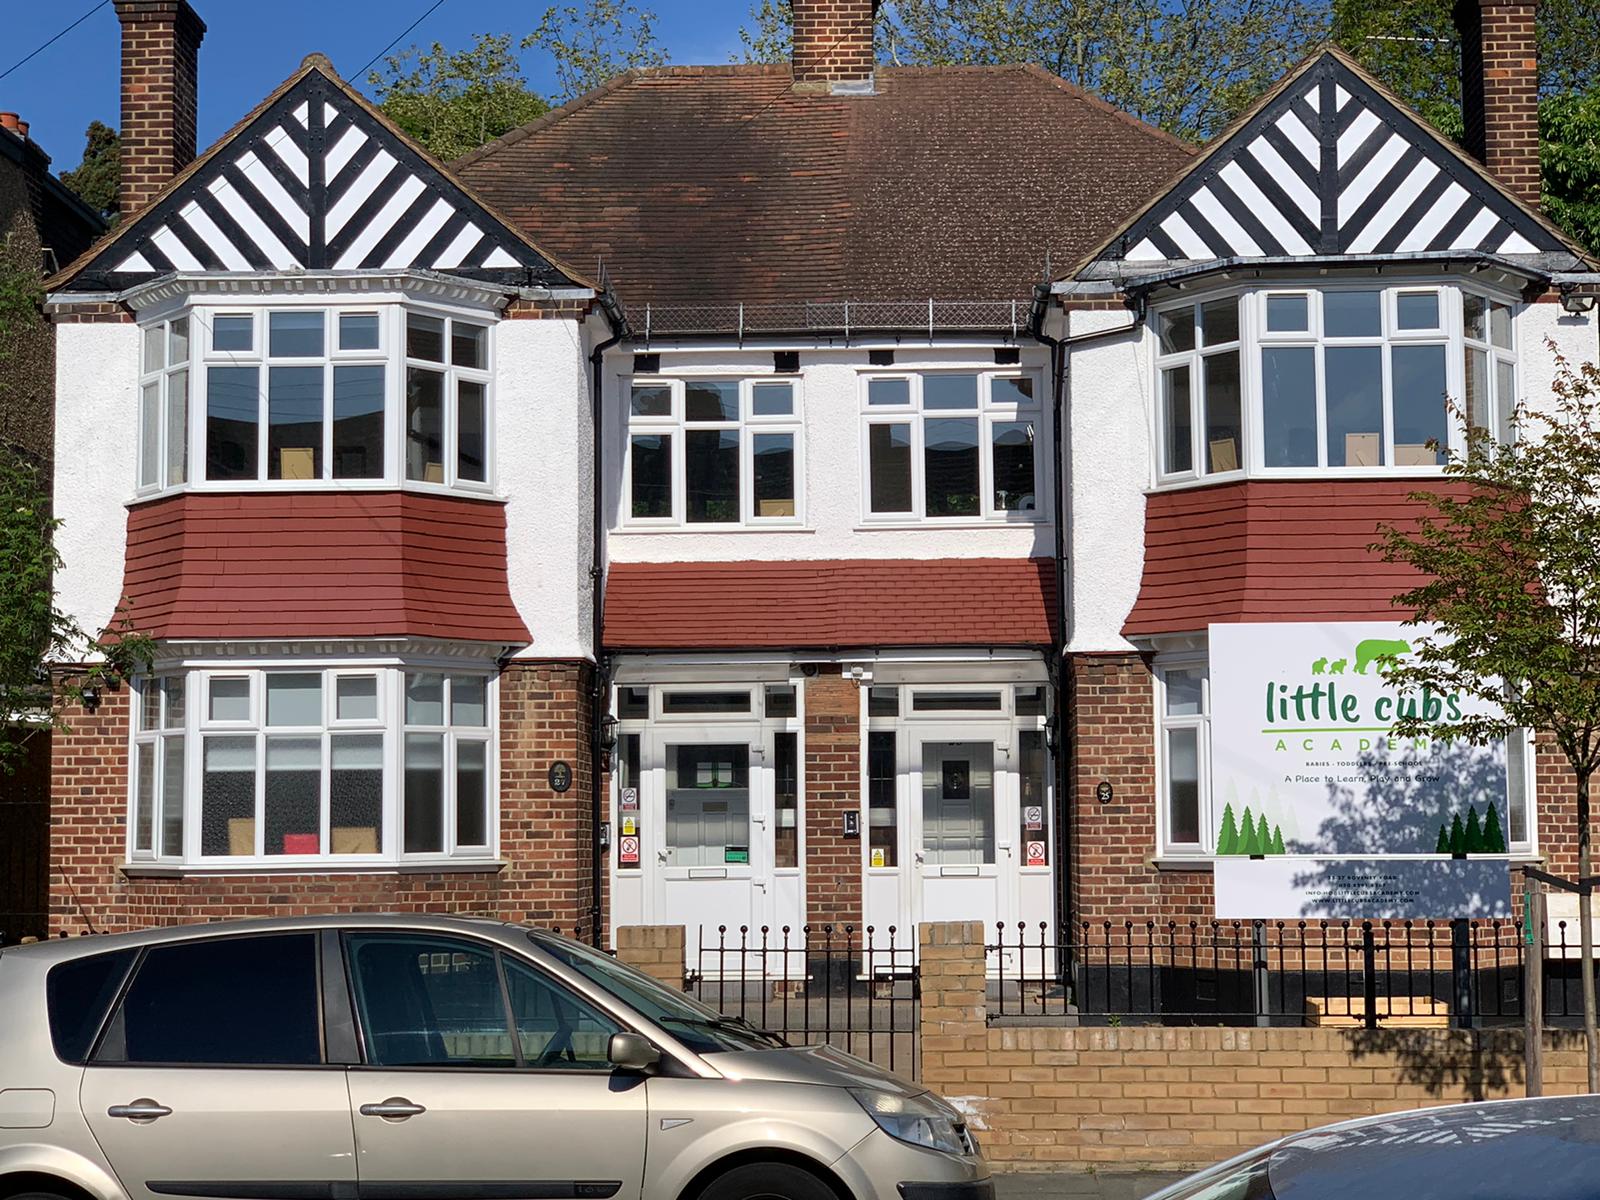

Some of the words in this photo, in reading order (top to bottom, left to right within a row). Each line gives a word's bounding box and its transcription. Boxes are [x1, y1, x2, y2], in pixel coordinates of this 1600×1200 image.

[1266, 681, 1360, 723] little
[1374, 682, 1462, 722] cubs
[1284, 775, 1292, 783] A
[1295, 775, 1320, 783] Place
[1324, 775, 1334, 783] to
[1337, 775, 1367, 784] Learn,
[1370, 775, 1390, 784] Play
[1394, 775, 1411, 783] and
[1415, 775, 1441, 783] Grow
